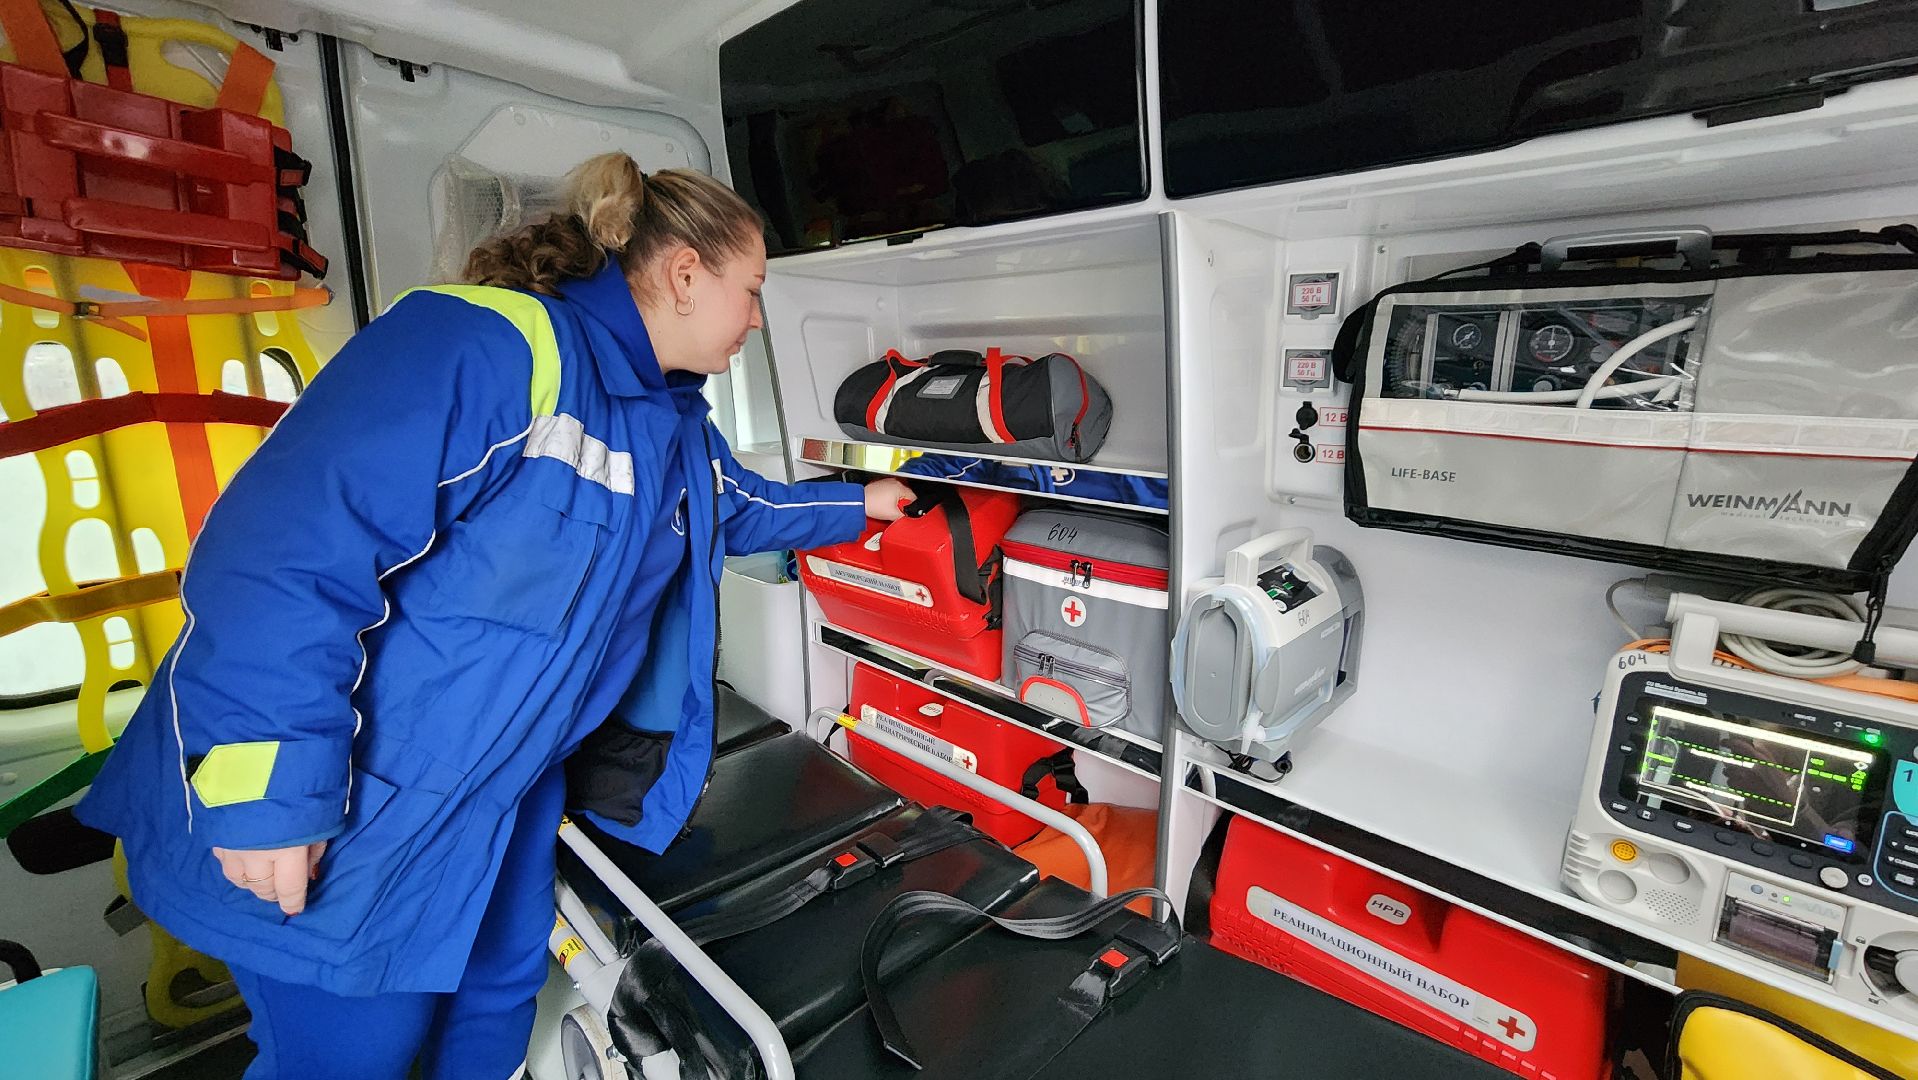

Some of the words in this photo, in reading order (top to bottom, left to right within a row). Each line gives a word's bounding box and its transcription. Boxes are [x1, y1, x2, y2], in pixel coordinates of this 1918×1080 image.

[1325, 412, 1337, 422] 12
[1340, 413, 1348, 422] В
[1322, 449, 1334, 458] 12
[1336, 450, 1345, 459] В
[1391, 467, 1456, 482] LIFE-BASE
[1687, 489, 1851, 519] WEINMANN
[1047, 523, 1079, 544] 604
[1618, 653, 1647, 669] 604
[1903, 769, 1913, 783] 1
[1273, 908, 1412, 983] РЕАНИМАЦИОННЫЙ
[1416, 977, 1470, 1008] НАБОР
